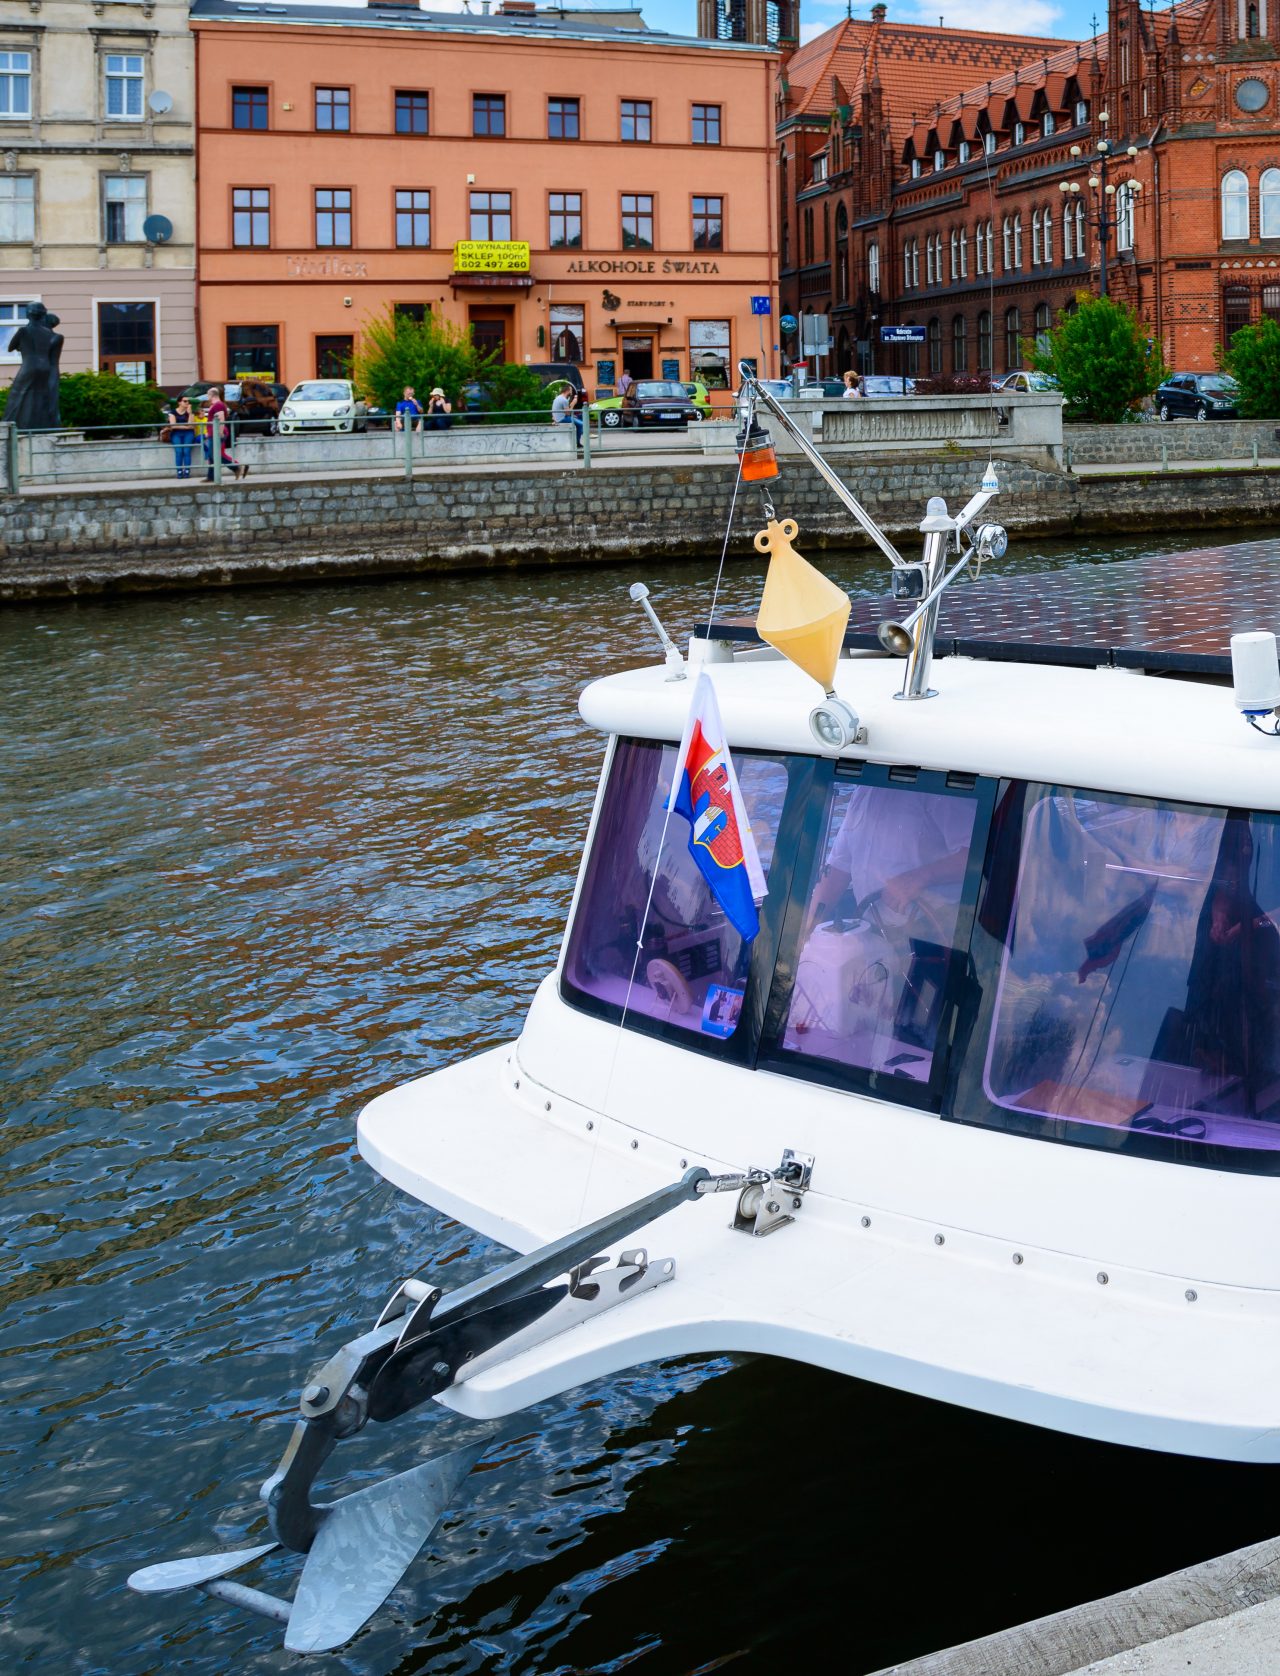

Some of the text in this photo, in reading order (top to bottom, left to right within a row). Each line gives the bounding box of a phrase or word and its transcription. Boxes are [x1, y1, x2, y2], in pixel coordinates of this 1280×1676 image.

[476, 243, 527, 251] WYNAJĘCIA
[567, 258, 720, 274] ALKOHOLE ŚWIATA
